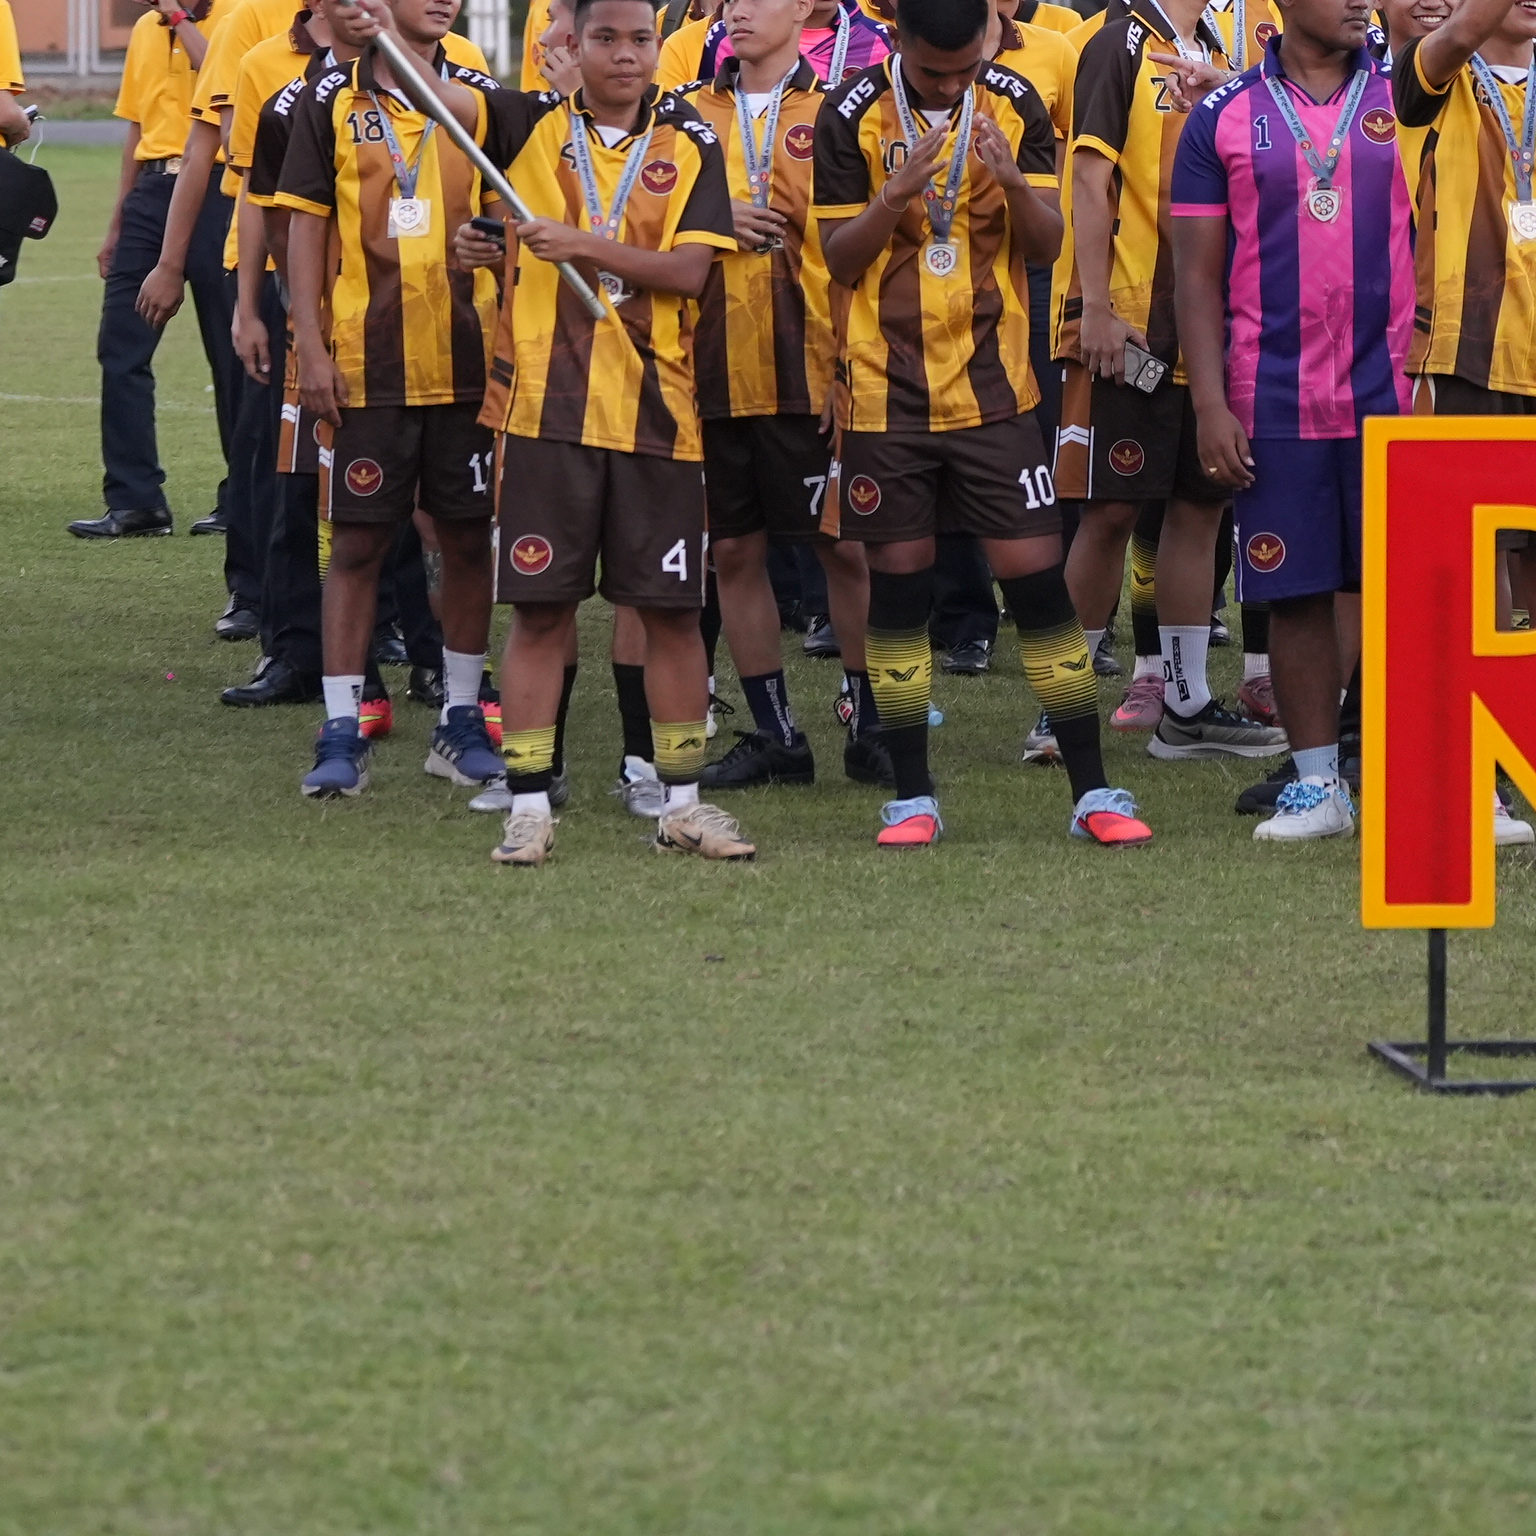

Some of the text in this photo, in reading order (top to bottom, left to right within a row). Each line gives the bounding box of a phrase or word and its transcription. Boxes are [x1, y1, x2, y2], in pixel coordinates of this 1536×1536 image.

[273, 76, 304, 117] RTS
[316, 70, 347, 104] RTS
[837, 76, 876, 120] RTS
[984, 68, 1029, 99] RTS
[1202, 76, 1244, 110] RTS
[346, 110, 386, 145] 18
[1253, 114, 1273, 150] 1
[803, 475, 826, 516] 7
[1018, 464, 1056, 510] 10
[661, 538, 687, 582] 4
